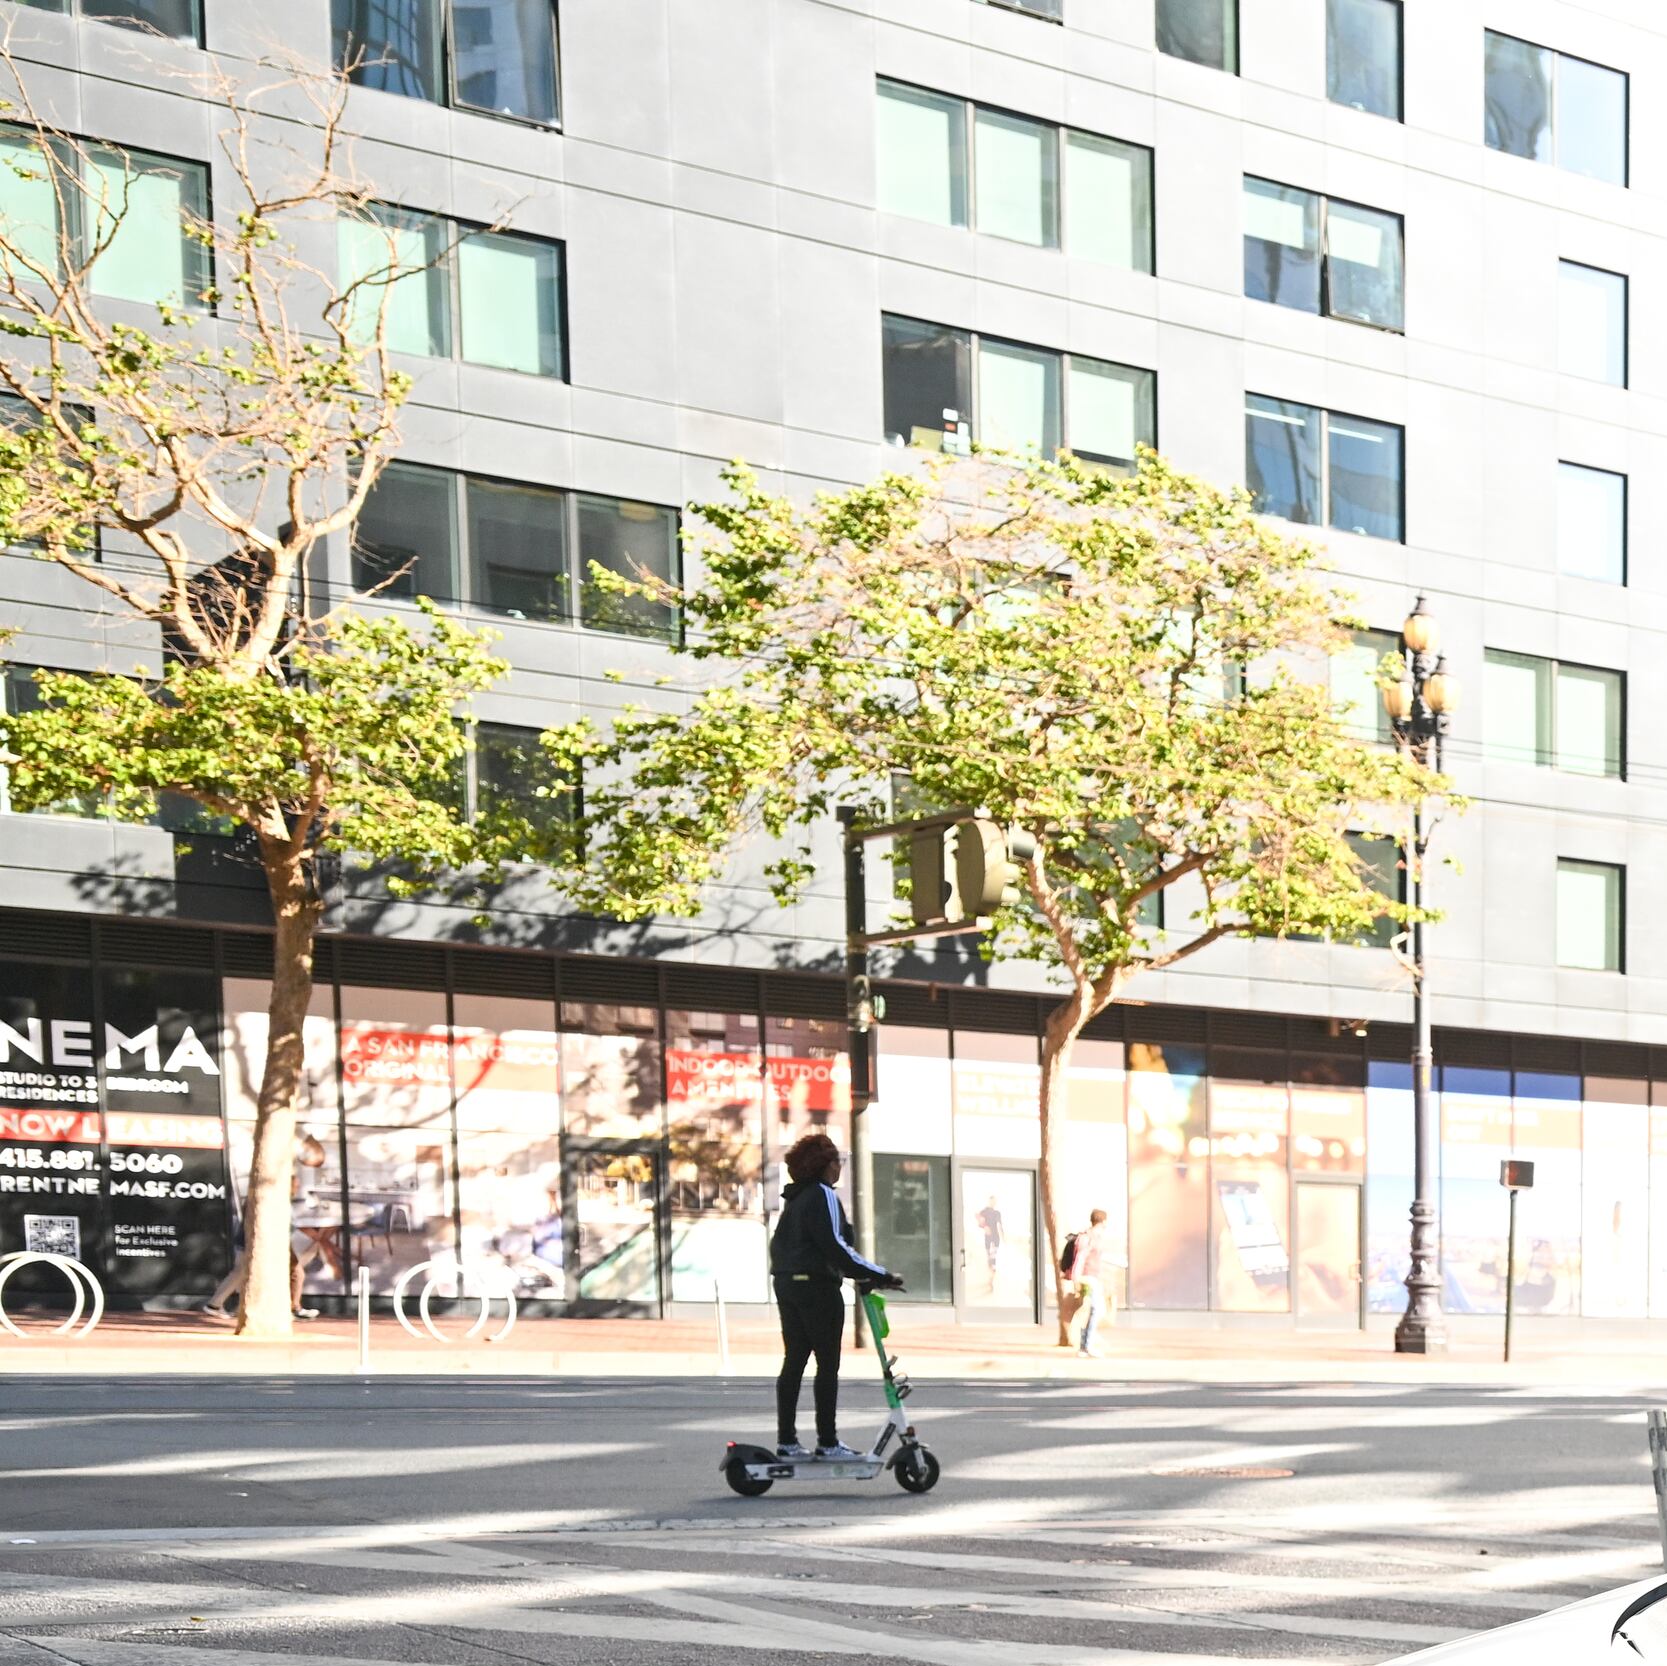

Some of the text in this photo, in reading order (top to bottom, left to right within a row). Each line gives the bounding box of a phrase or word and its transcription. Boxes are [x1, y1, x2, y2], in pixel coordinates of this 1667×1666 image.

[0, 1016, 221, 1076] NEMA
[368, 1036, 415, 1057] SAN
[0, 1071, 57, 1087] STUDIO
[59, 1074, 83, 1089] TO
[0, 1086, 99, 1104] RESIDENCES
[0, 1112, 76, 1138] NOW
[114, 1223, 176, 1236] SCAN HERE
